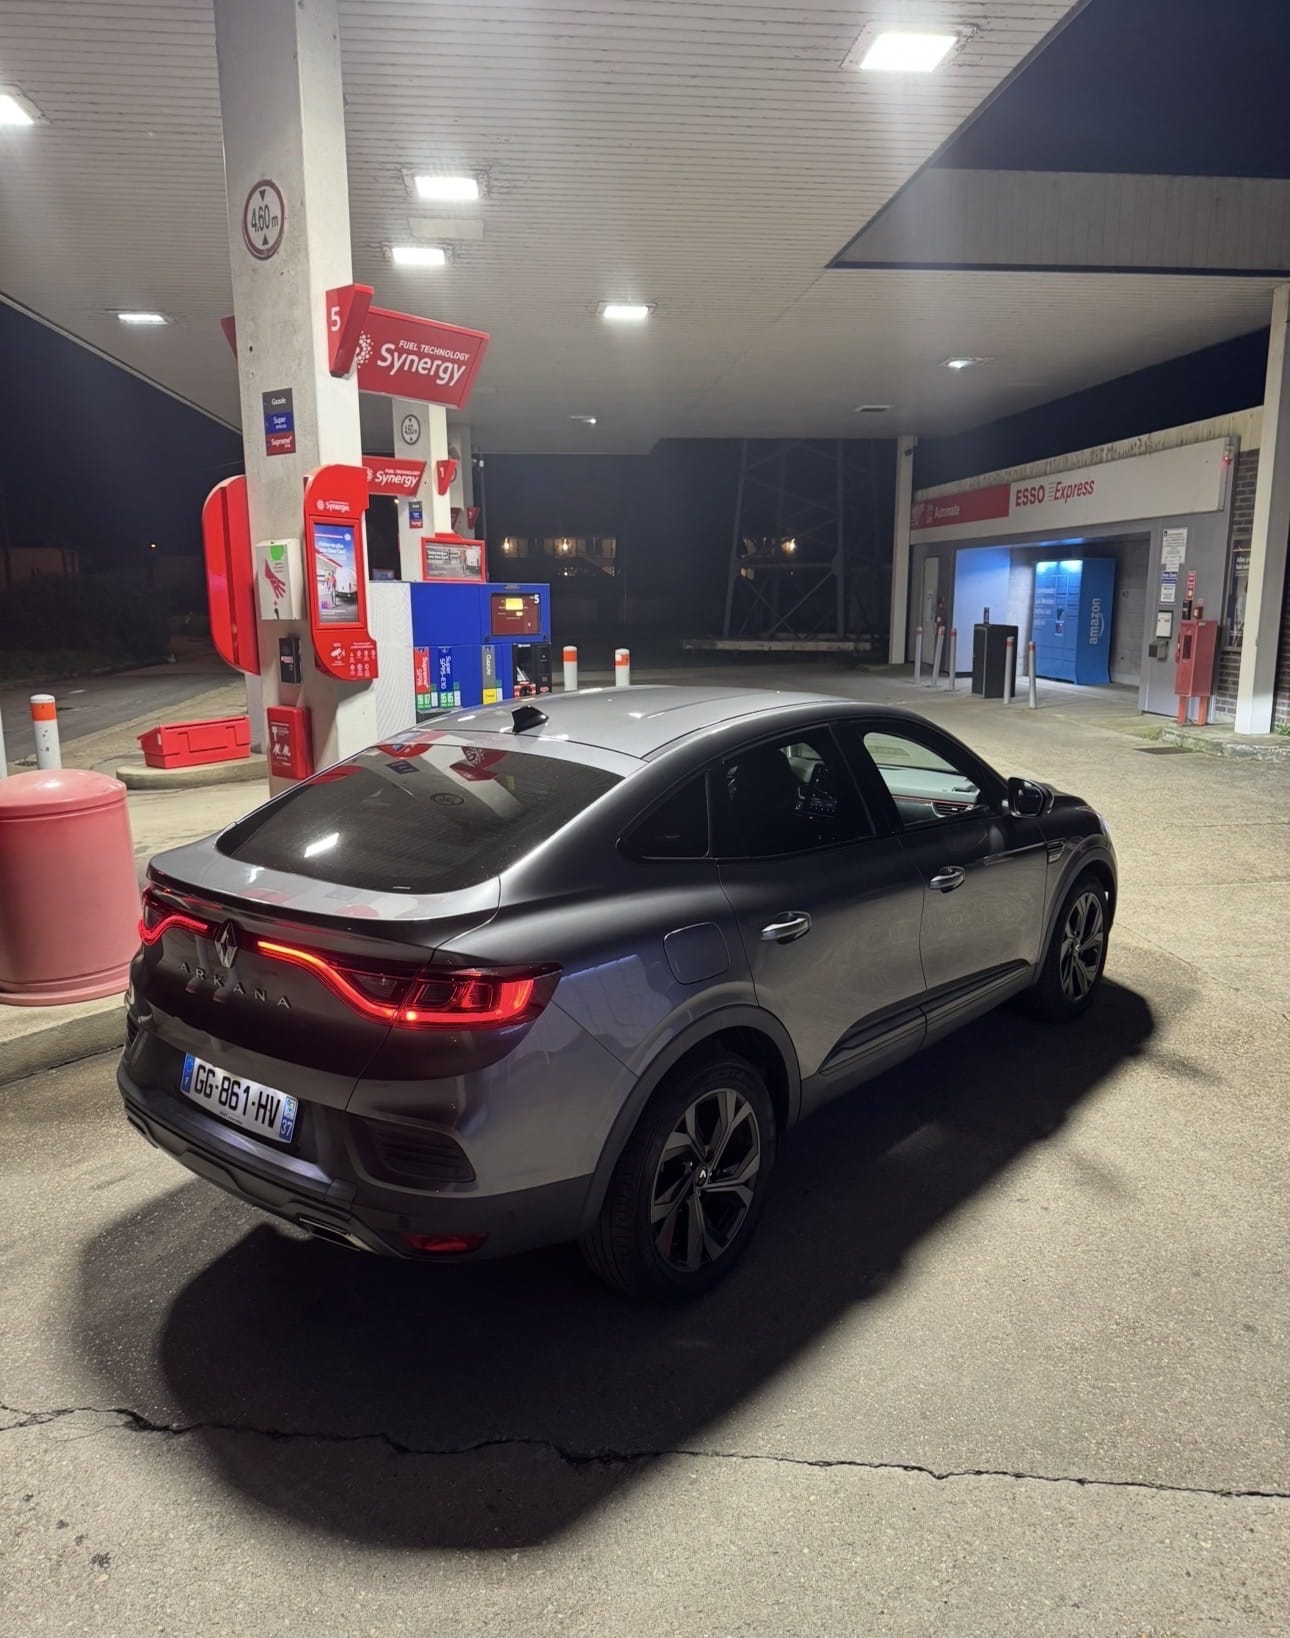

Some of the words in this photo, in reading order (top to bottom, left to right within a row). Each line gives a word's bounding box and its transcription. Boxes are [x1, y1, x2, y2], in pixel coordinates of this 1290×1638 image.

[330, 306, 341, 332] 5
[398, 339, 418, 351] FUEL
[420, 344, 471, 361] TECHNOLOGY
[376, 342, 467, 387] Synergy
[375, 470, 419, 489] Synergy
[1015, 484, 1046, 507] ESSO
[1053, 479, 1096, 504] Express
[533, 594, 540, 604] 5
[1088, 598, 1102, 645] amazon
[181, 961, 292, 1009] ARKANA
[194, 1063, 282, 1129] GG-861-HV
[280, 1119, 293, 1137] 37
